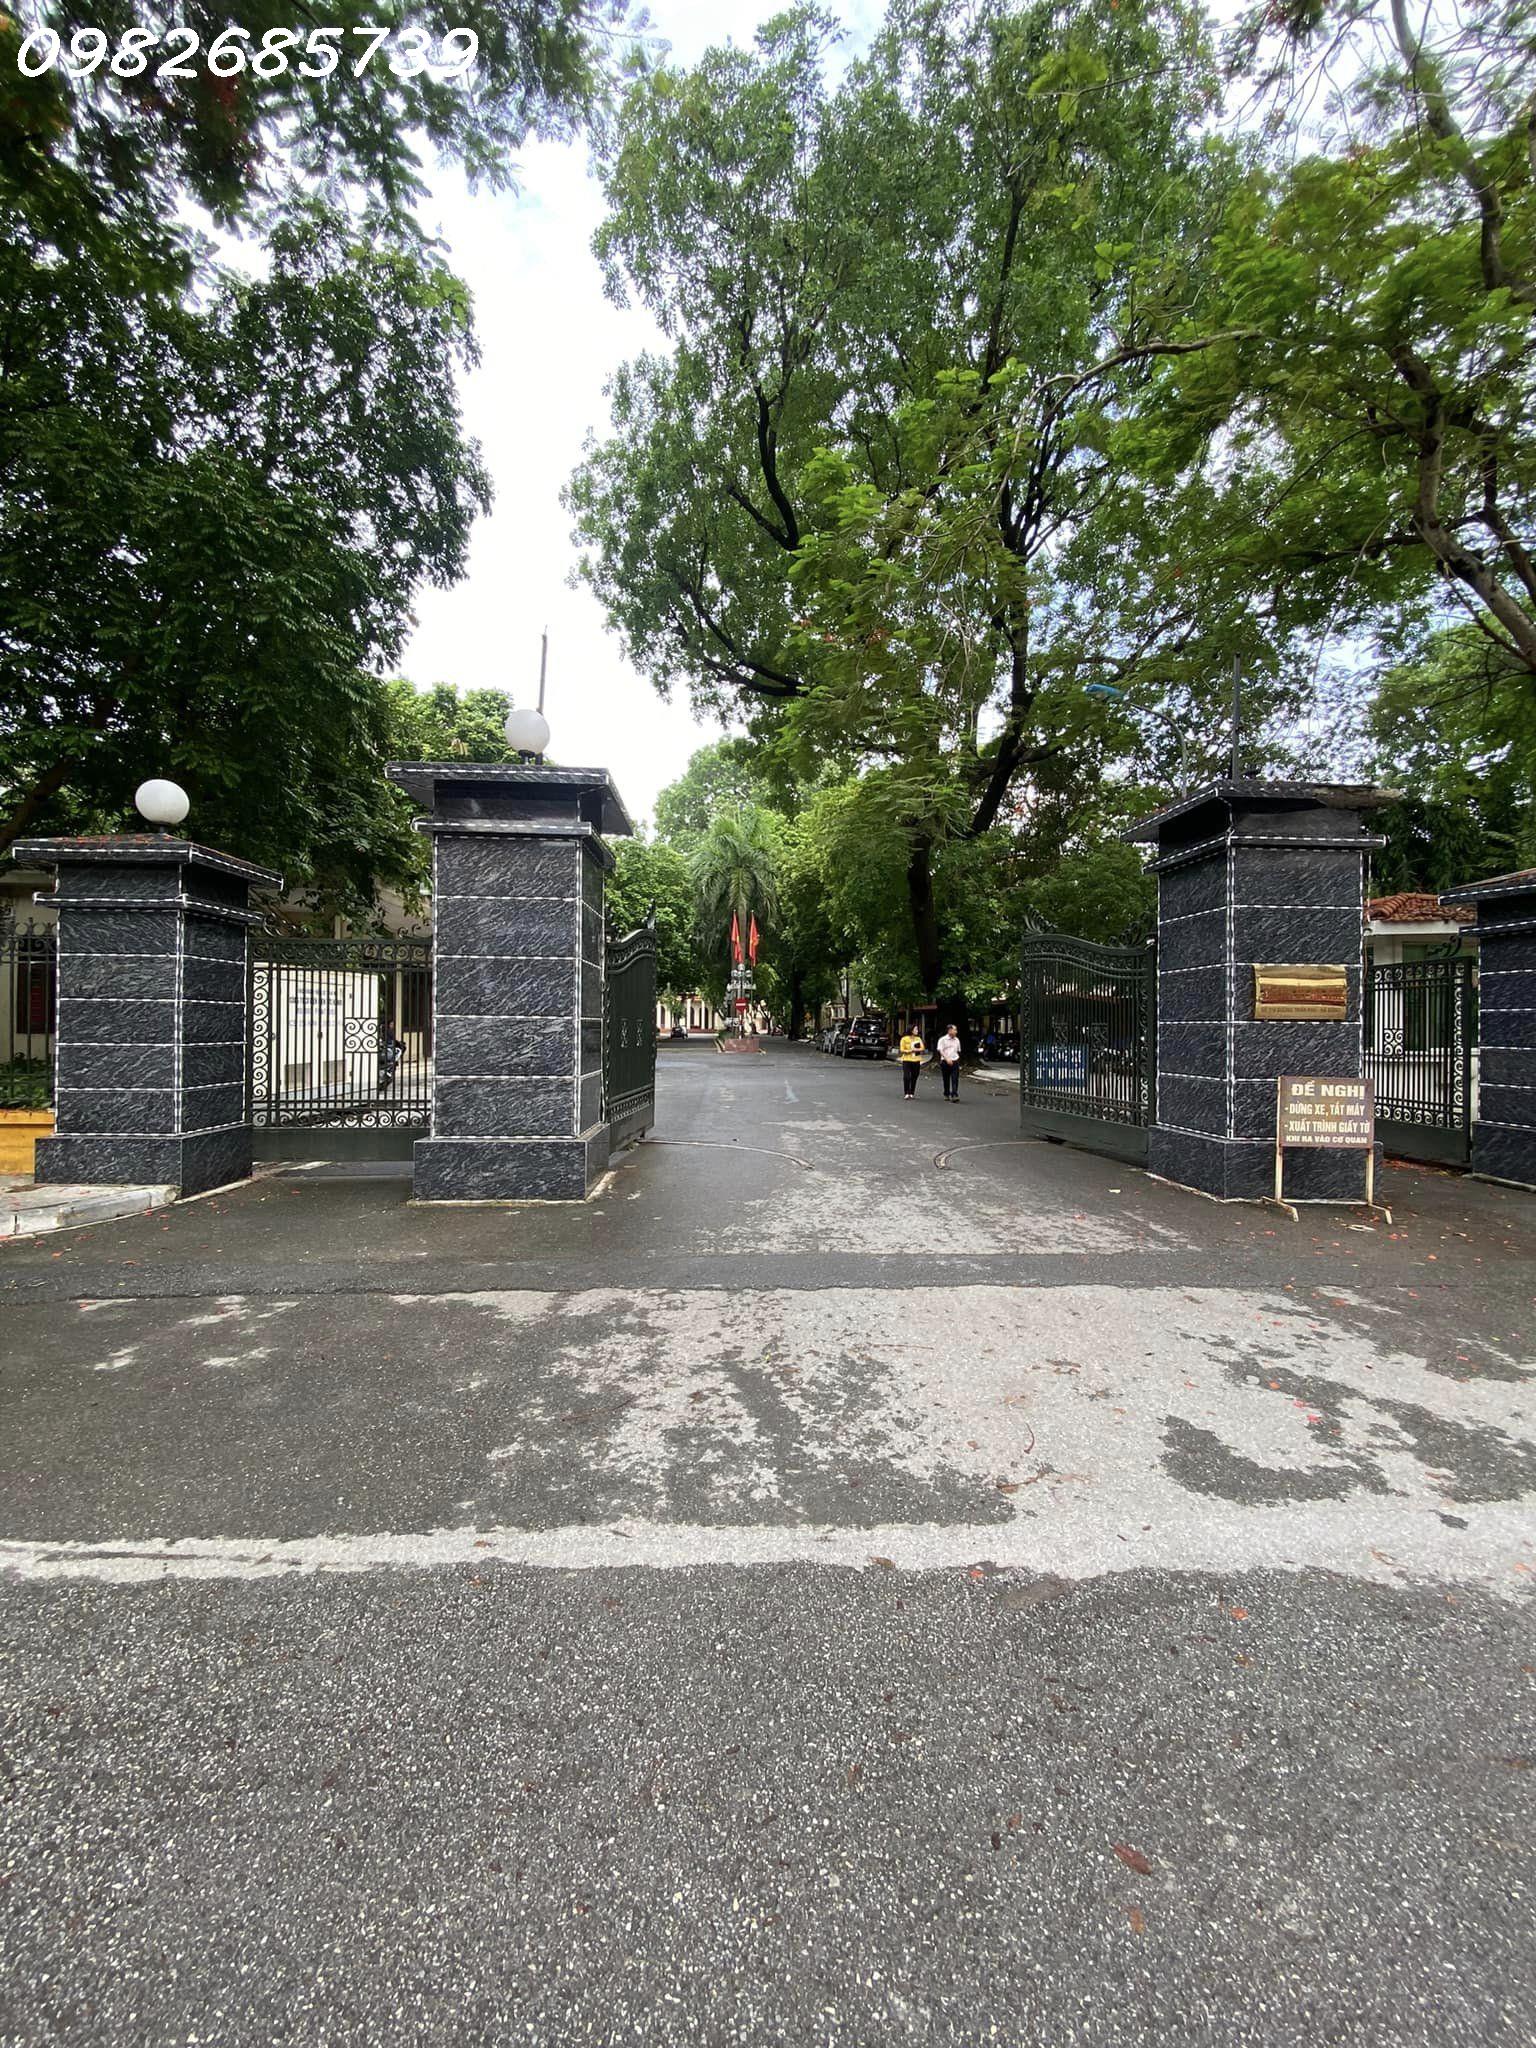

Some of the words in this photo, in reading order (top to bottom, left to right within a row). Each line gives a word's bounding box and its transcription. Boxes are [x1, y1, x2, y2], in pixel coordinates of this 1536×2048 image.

[1321, 1084, 1365, 1100] NGHỊ
[1315, 1103, 1329, 1116] XE,
[1346, 1102, 1365, 1116] MÁY
[1312, 1119, 1337, 1133] TRÌNH
[1338, 1119, 1358, 1133] GIẤY
[1314, 1134, 1330, 1143] VÀO
[1345, 1136, 1368, 1144] QUAN
